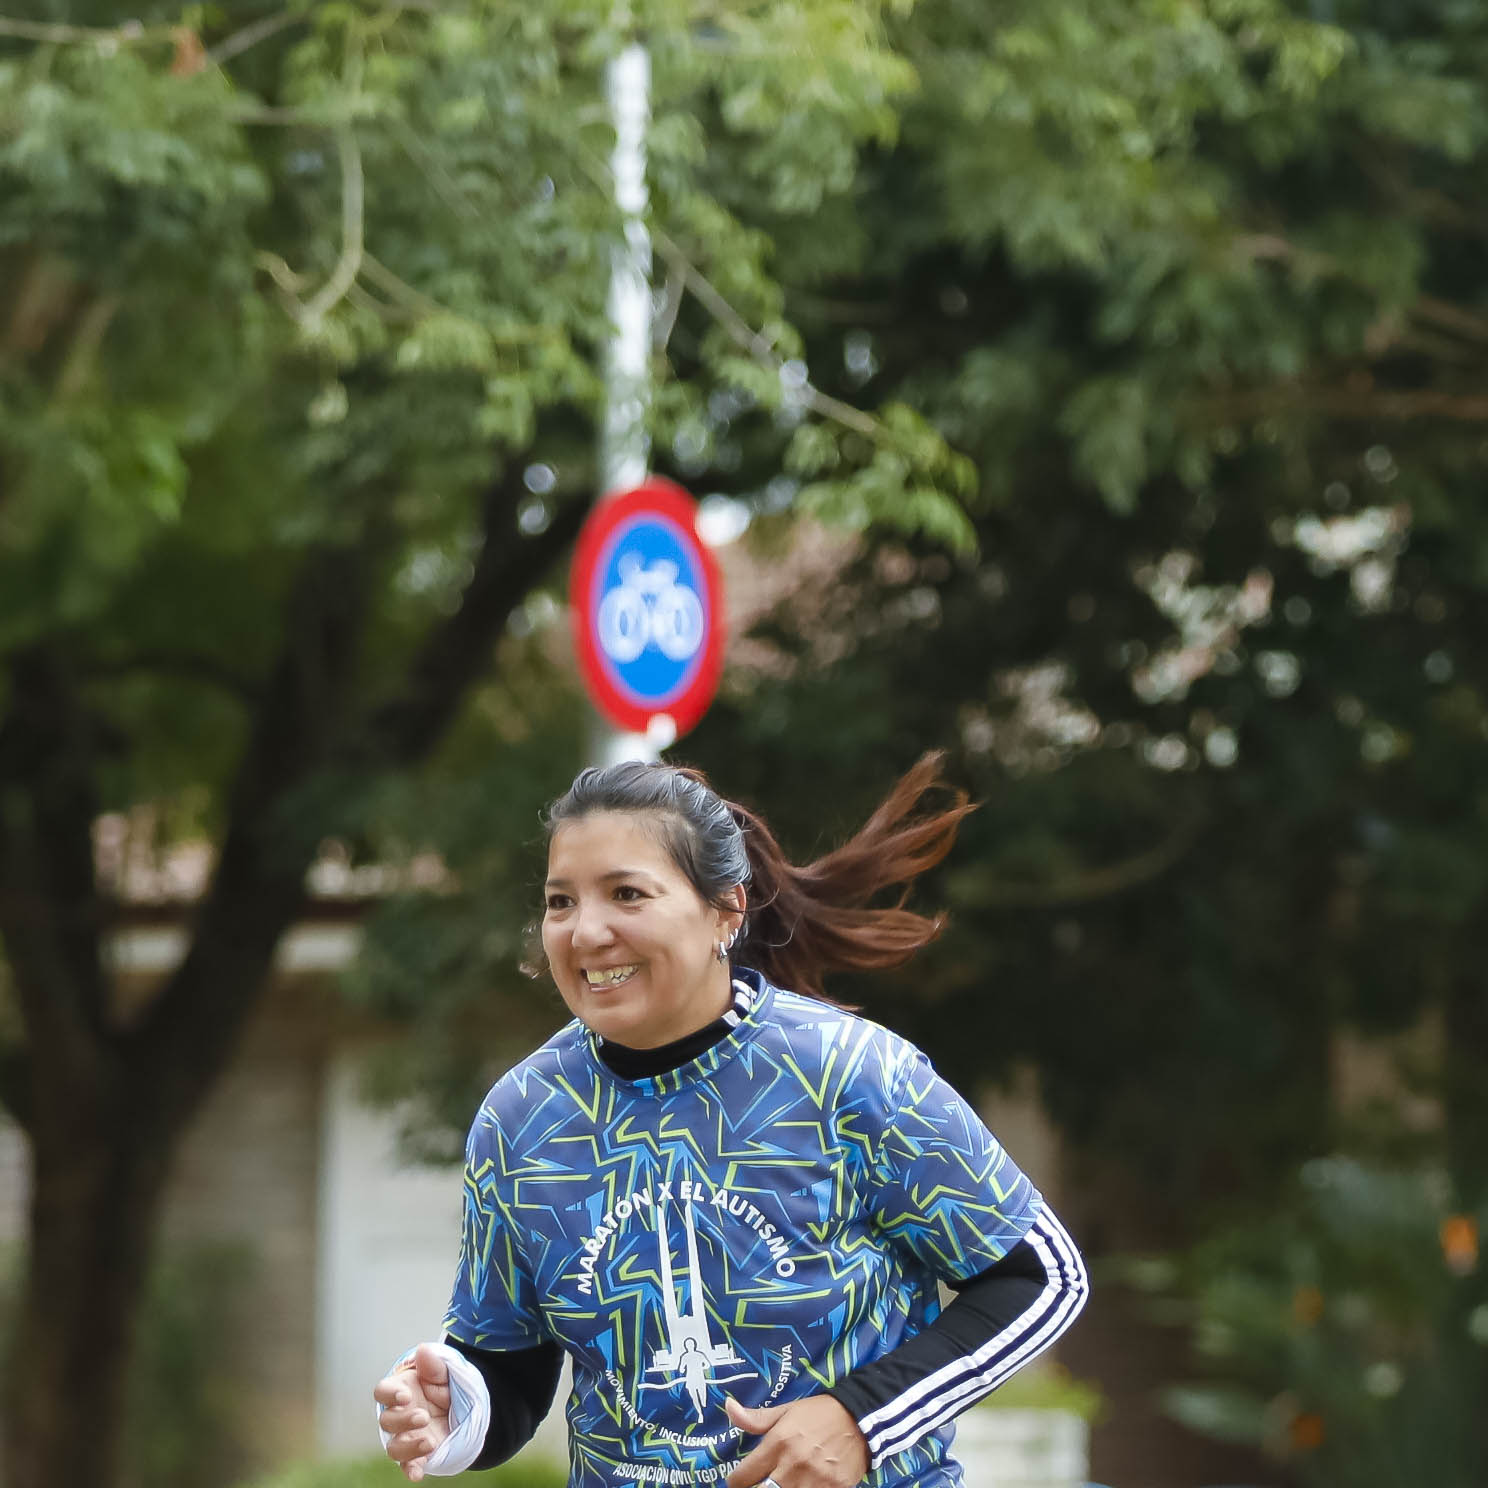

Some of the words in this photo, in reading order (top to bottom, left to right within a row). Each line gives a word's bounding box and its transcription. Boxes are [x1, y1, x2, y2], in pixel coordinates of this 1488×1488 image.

[577, 1187, 652, 1295] MARATÓN
[657, 1181, 674, 1202] X
[680, 1180, 705, 1202] EL
[710, 1188, 796, 1278] AUTISMO
[659, 1426, 718, 1447] INCLUSIÓN
[719, 1432, 728, 1443] Y
[770, 1343, 793, 1399] POSITIVA
[613, 1462, 669, 1484] ASOCIACIÓN
[670, 1469, 695, 1485] CIVIL
[695, 1467, 718, 1484] TGD
